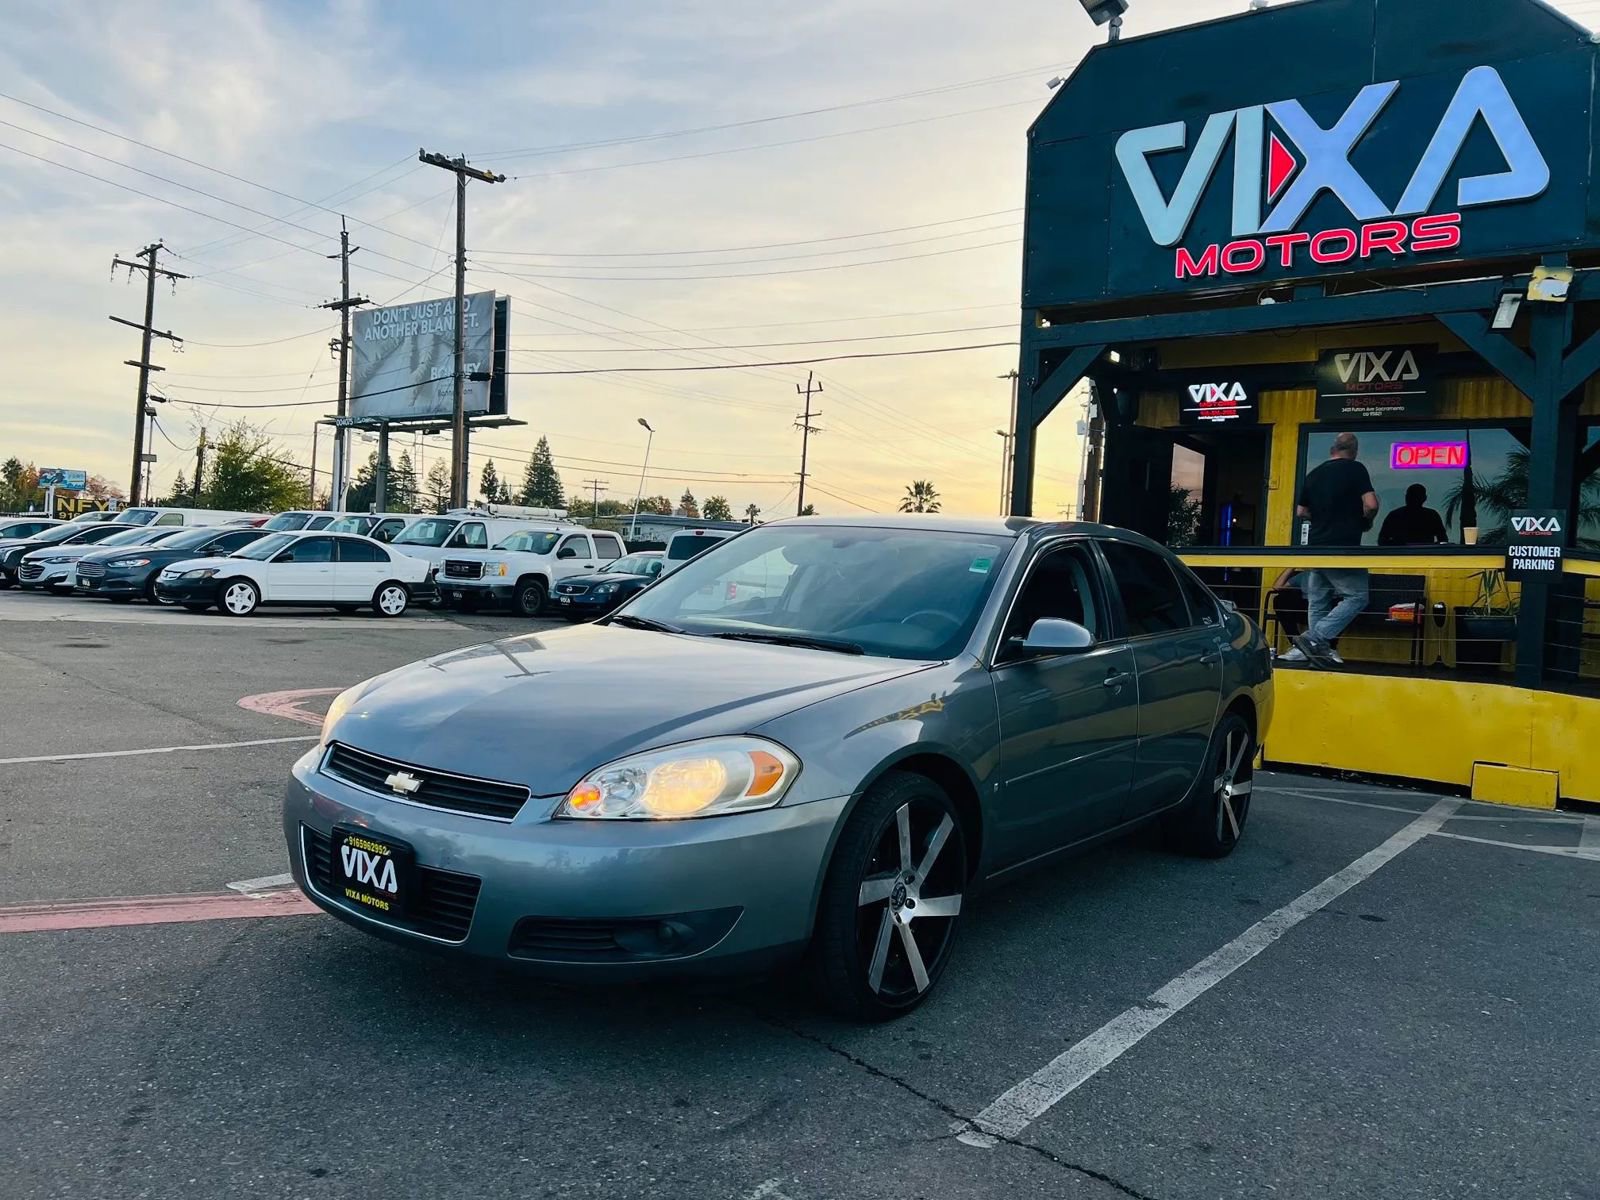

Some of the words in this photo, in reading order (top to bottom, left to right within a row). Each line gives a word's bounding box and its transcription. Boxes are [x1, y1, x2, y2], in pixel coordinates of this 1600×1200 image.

[1115, 66, 1550, 246] VIXA
[1175, 212, 1462, 279] MOTORS
[373, 307, 410, 325] DON'T
[411, 302, 442, 320] JUST
[443, 299, 471, 316] AD
[364, 322, 418, 341] ANOTHER
[421, 312, 479, 336] BLANET.
[1334, 350, 1420, 383] VIXA
[1188, 381, 1247, 403] VIXA
[1397, 446, 1464, 465] OPEN
[1511, 516, 1561, 532] VIXA
[1509, 545, 1561, 557] CUSTOMER
[1512, 558, 1555, 570] PARKING
[341, 845, 398, 894] VIXA
[345, 888, 361, 901] VIXA
[361, 893, 389, 911] MOTORS
